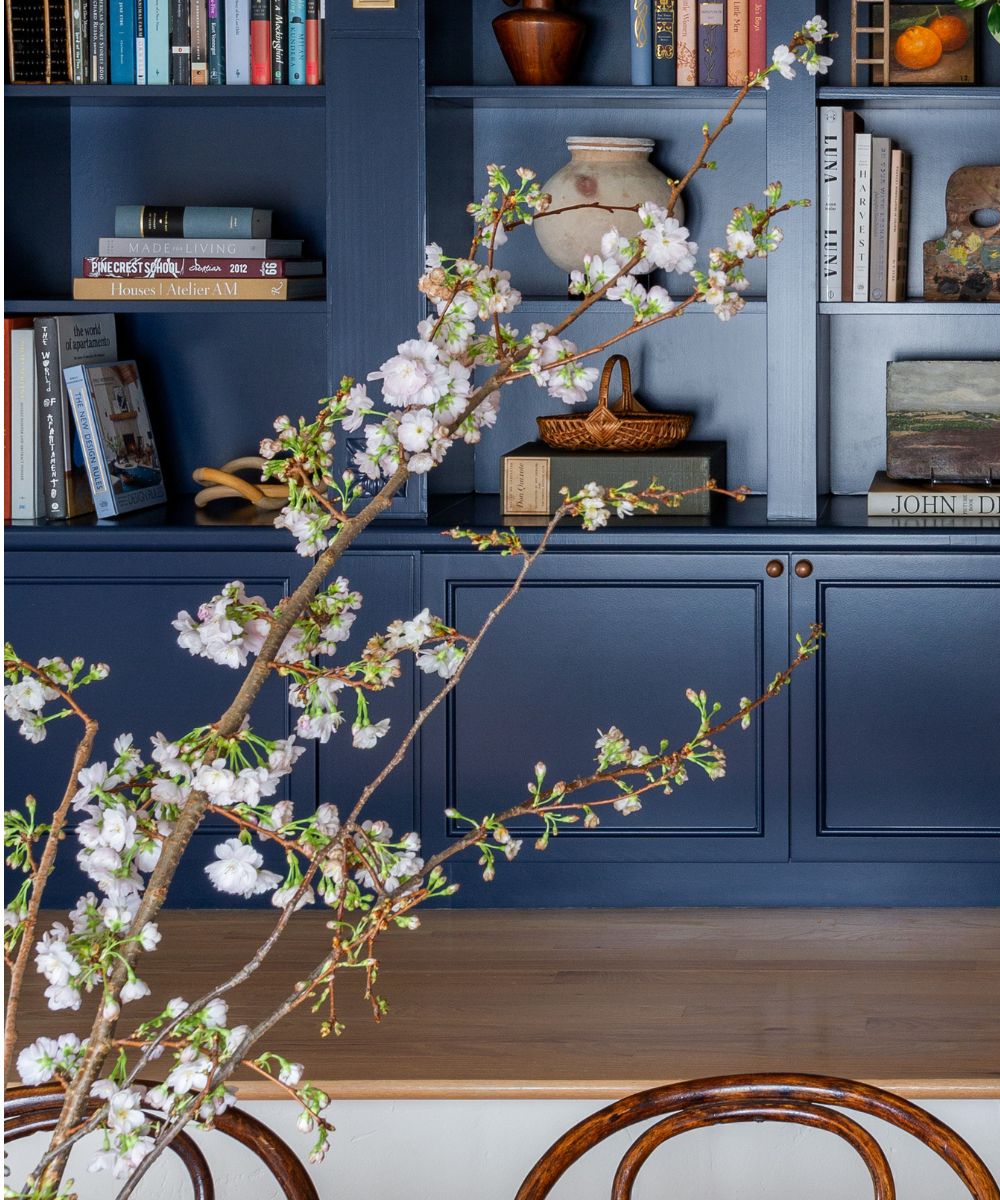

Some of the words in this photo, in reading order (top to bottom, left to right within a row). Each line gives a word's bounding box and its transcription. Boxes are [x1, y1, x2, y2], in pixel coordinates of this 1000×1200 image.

[272, 14, 284, 64] Mockingbird
[824, 135, 837, 184] LUNA
[129, 243, 170, 254] MADE
[185, 243, 236, 254] LIVING
[824, 230, 837, 278] LUNA
[92, 262, 113, 274] PINE
[113, 262, 144, 274] CREST
[144, 262, 180, 274] SCHOOL
[230, 263, 248, 273] 2012
[111, 282, 156, 296] Houses
[169, 282, 210, 296] Atelier
[212, 282, 238, 295] AM
[40, 326, 48, 346] THE
[84, 326, 101, 336] world
[75, 338, 110, 352] apartamento
[42, 352, 52, 392] WORLD
[43, 398, 56, 408] OF
[74, 392, 84, 408] THE
[80, 411, 90, 430] NEW
[46, 414, 59, 498] APARTAMENTO
[84, 434, 98, 464] DESIGN
[91, 466, 104, 490] RULES
[891, 494, 958, 514] JOHN
